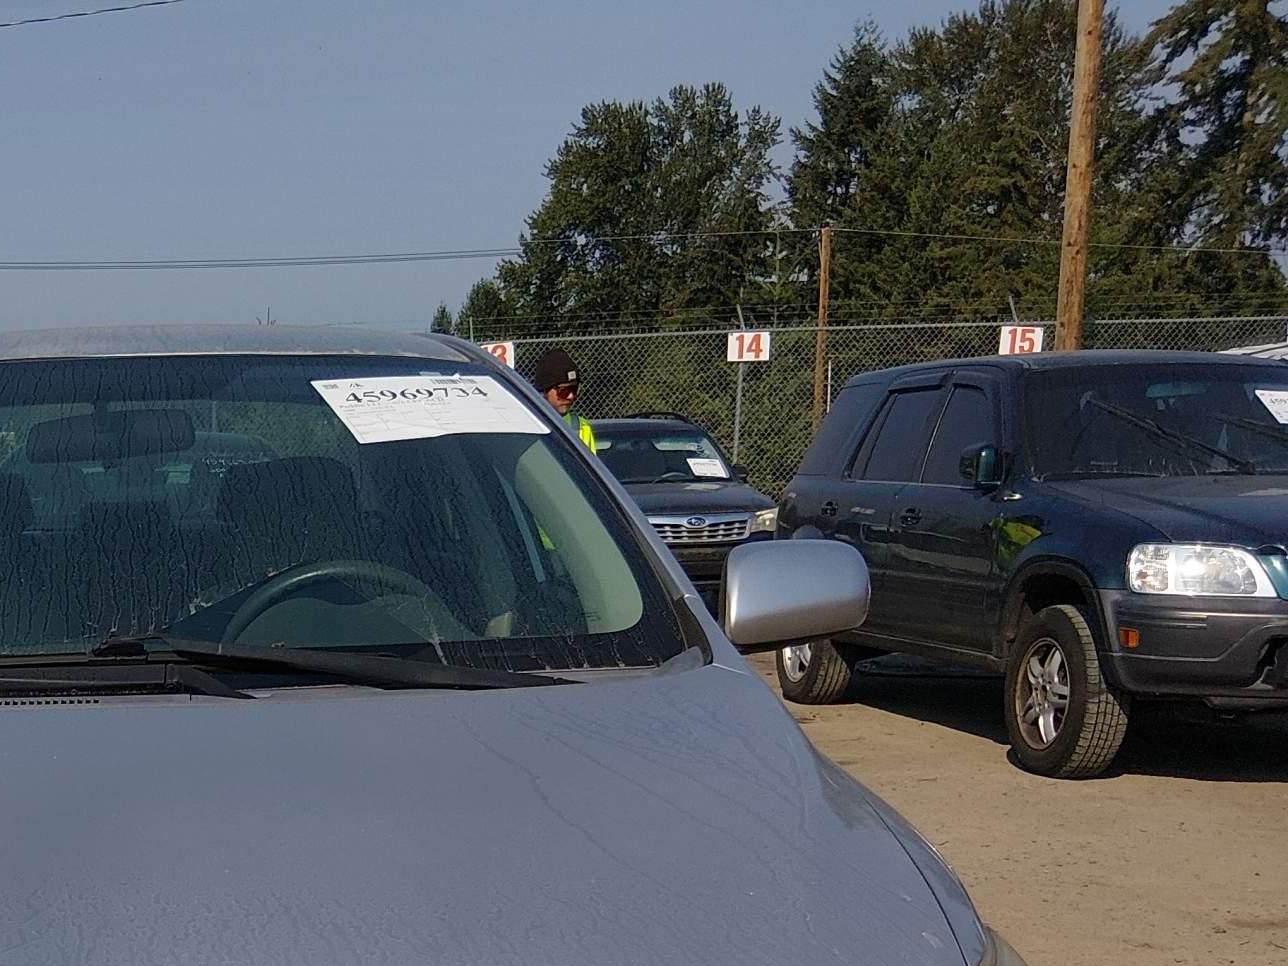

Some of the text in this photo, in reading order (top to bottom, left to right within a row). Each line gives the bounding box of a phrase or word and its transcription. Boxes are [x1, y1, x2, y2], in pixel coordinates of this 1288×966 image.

[736, 334, 763, 359] 14
[1008, 328, 1035, 353] 15
[482, 345, 507, 366] 3
[345, 386, 489, 403] 45969734
